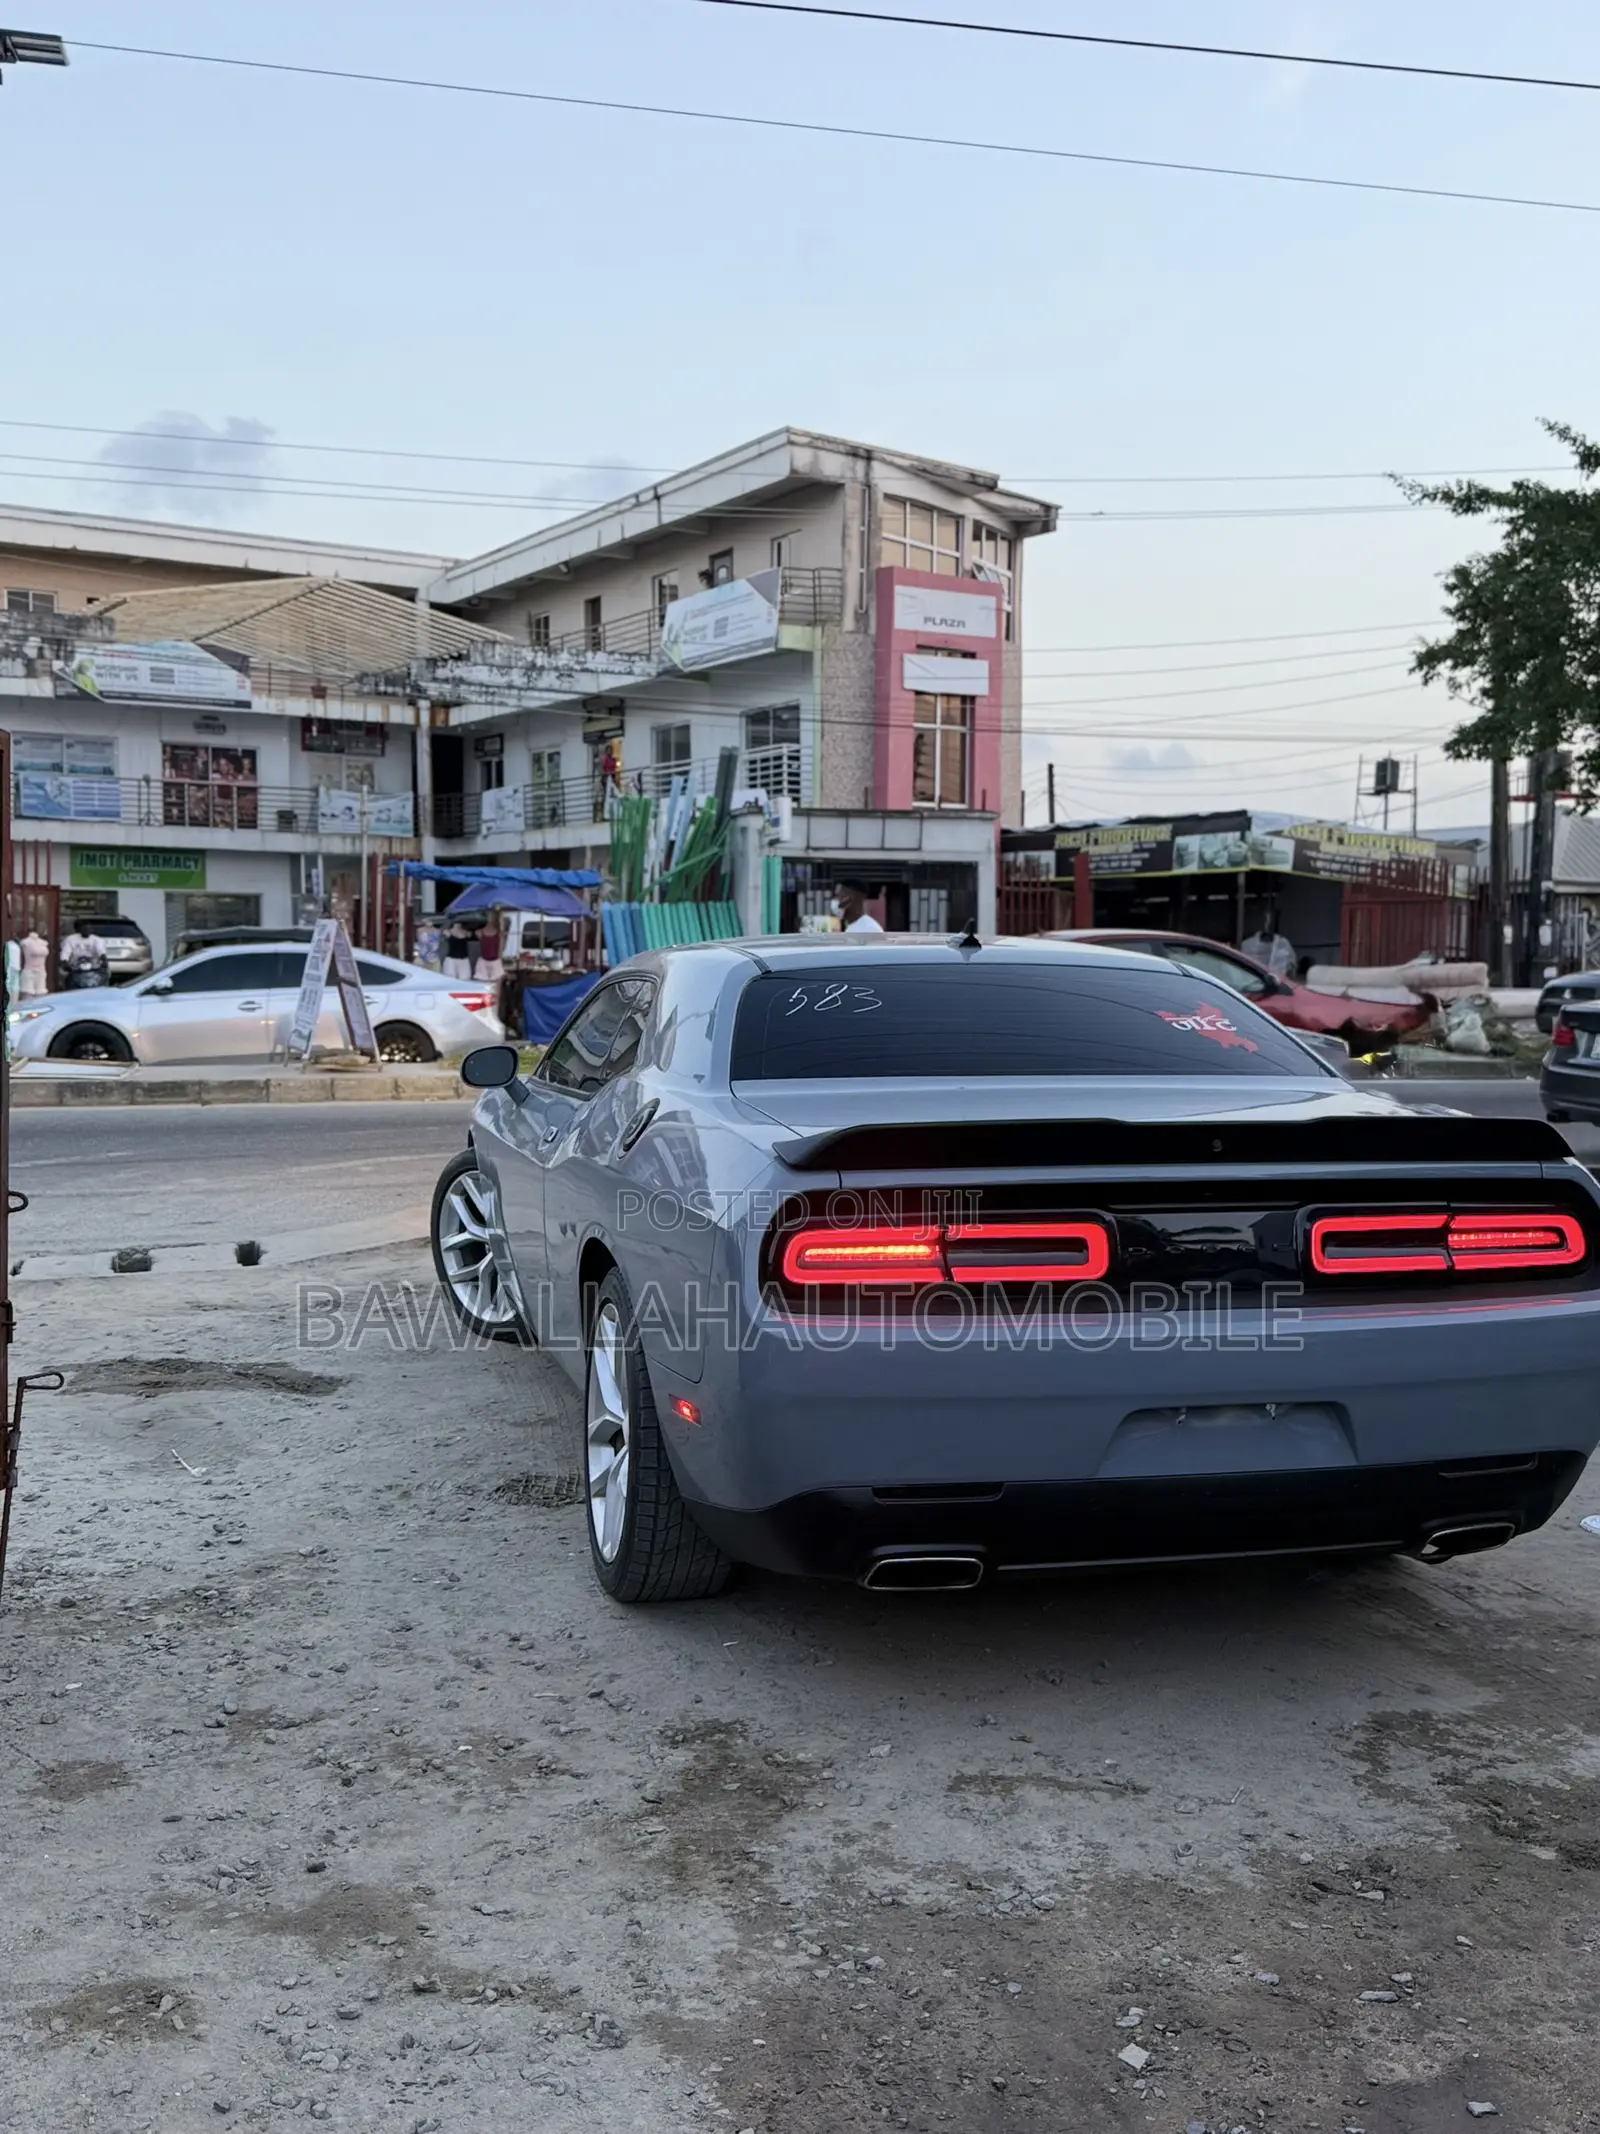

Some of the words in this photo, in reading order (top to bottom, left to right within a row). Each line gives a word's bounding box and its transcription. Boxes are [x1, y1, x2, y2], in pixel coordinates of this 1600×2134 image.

[923, 616, 966, 629] PLAZA
[121, 853, 200, 871] PHARMACY
[785, 984, 882, 1016] 583
